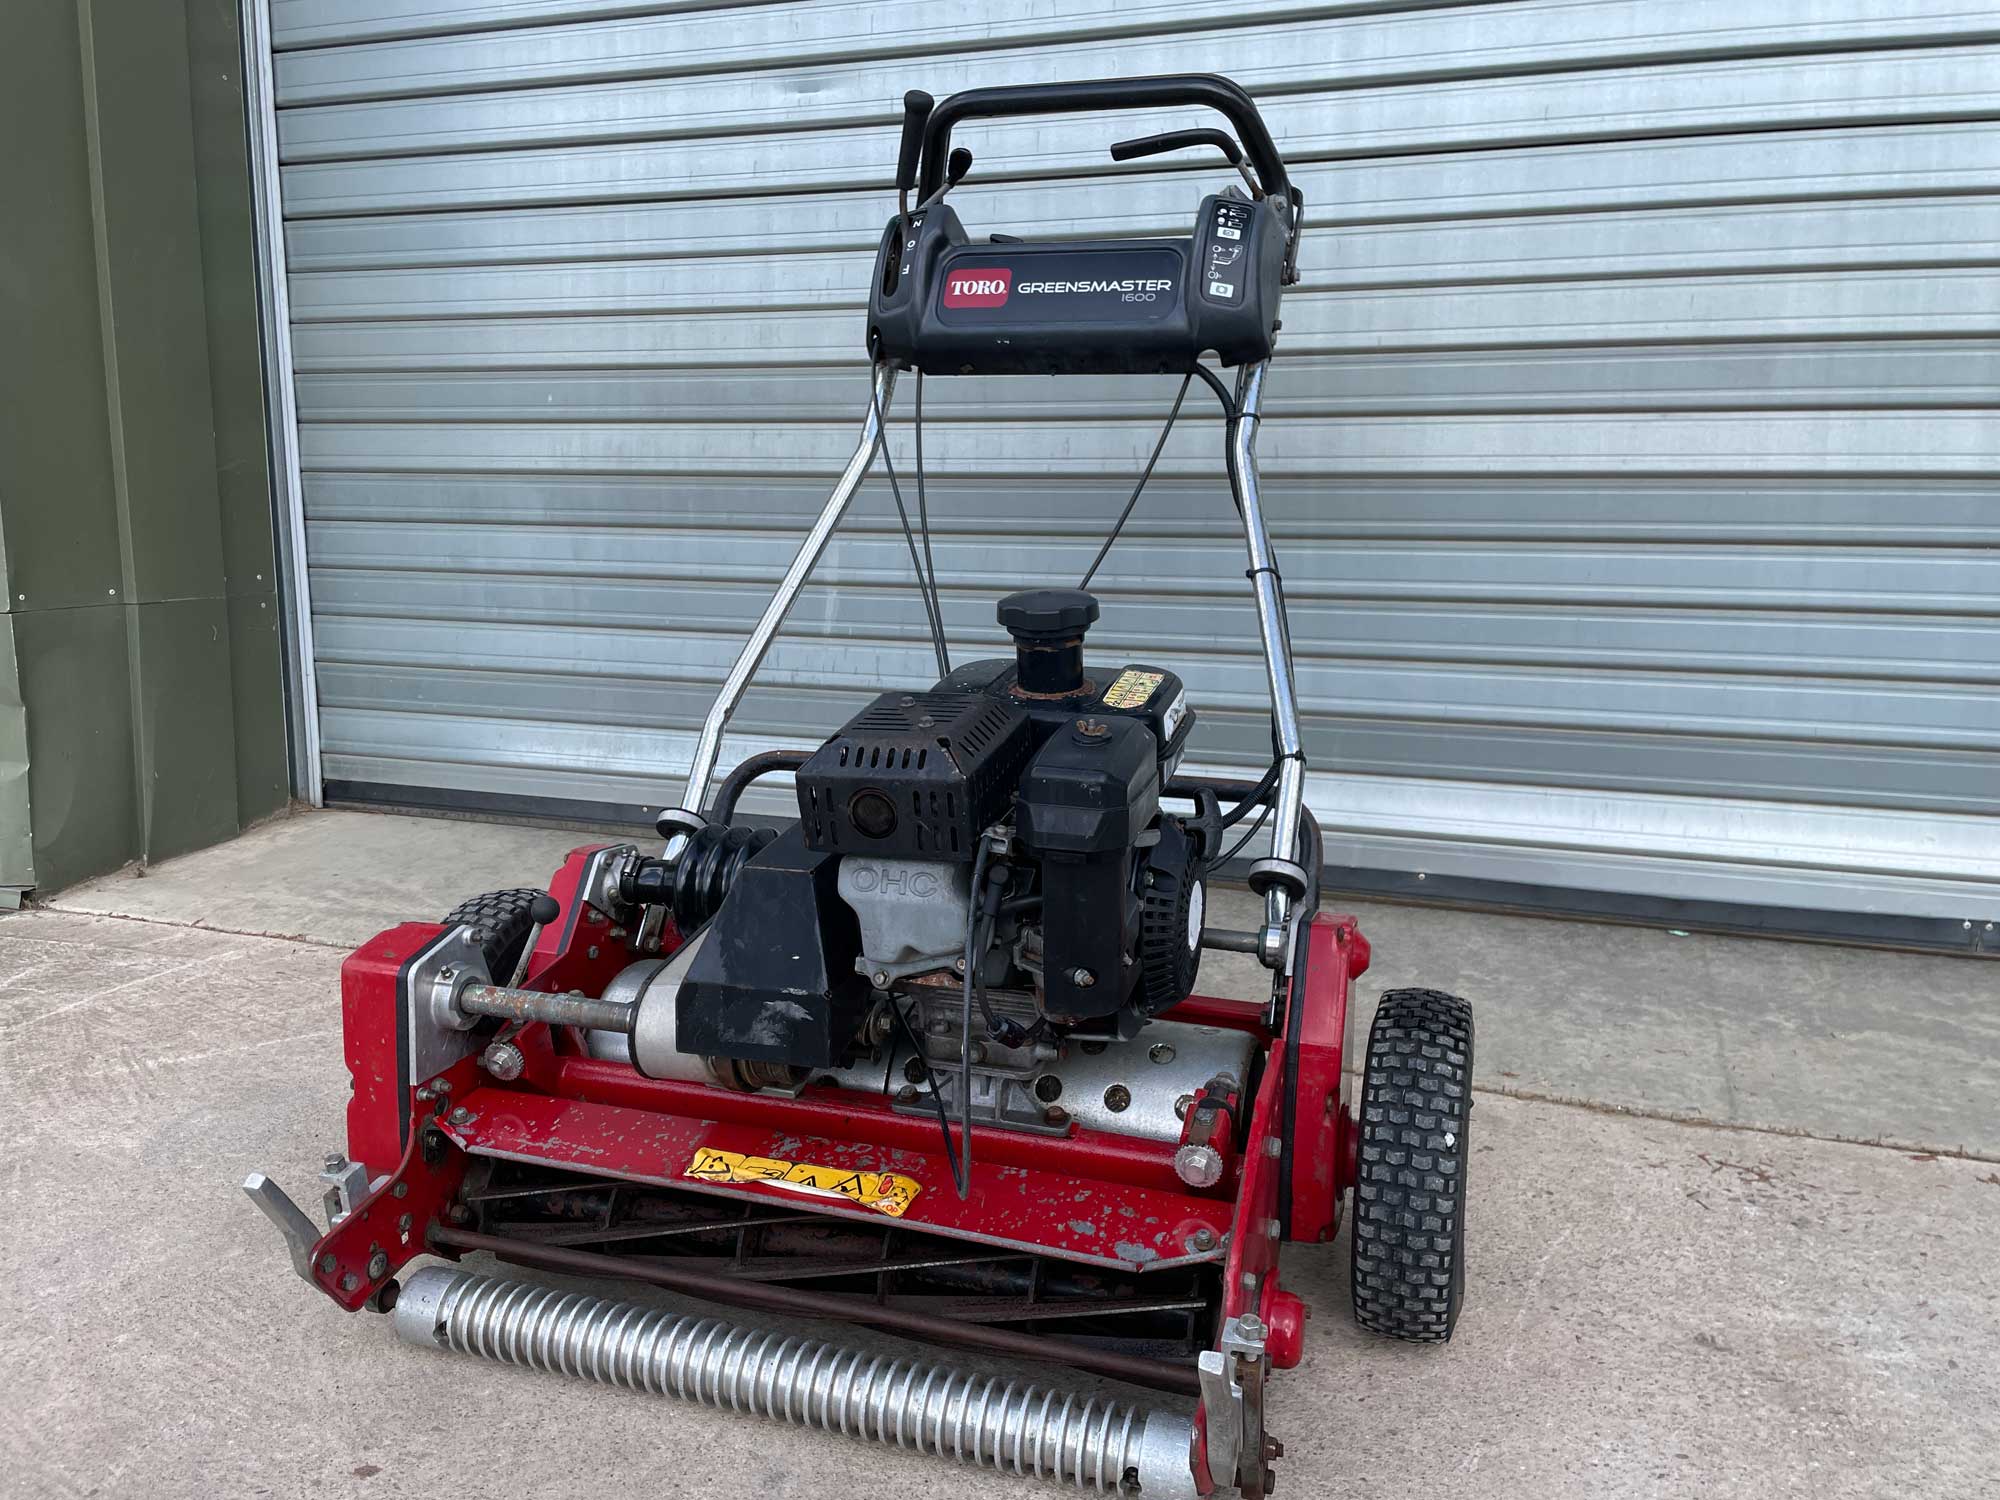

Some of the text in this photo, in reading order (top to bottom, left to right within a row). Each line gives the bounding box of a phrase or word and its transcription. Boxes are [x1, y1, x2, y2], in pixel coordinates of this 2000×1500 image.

[951, 280, 1005, 296] TORO
[1018, 280, 1172, 294] GREENSMASTER
[1121, 293, 1156, 302] 1600
[851, 866, 938, 897] OHC
